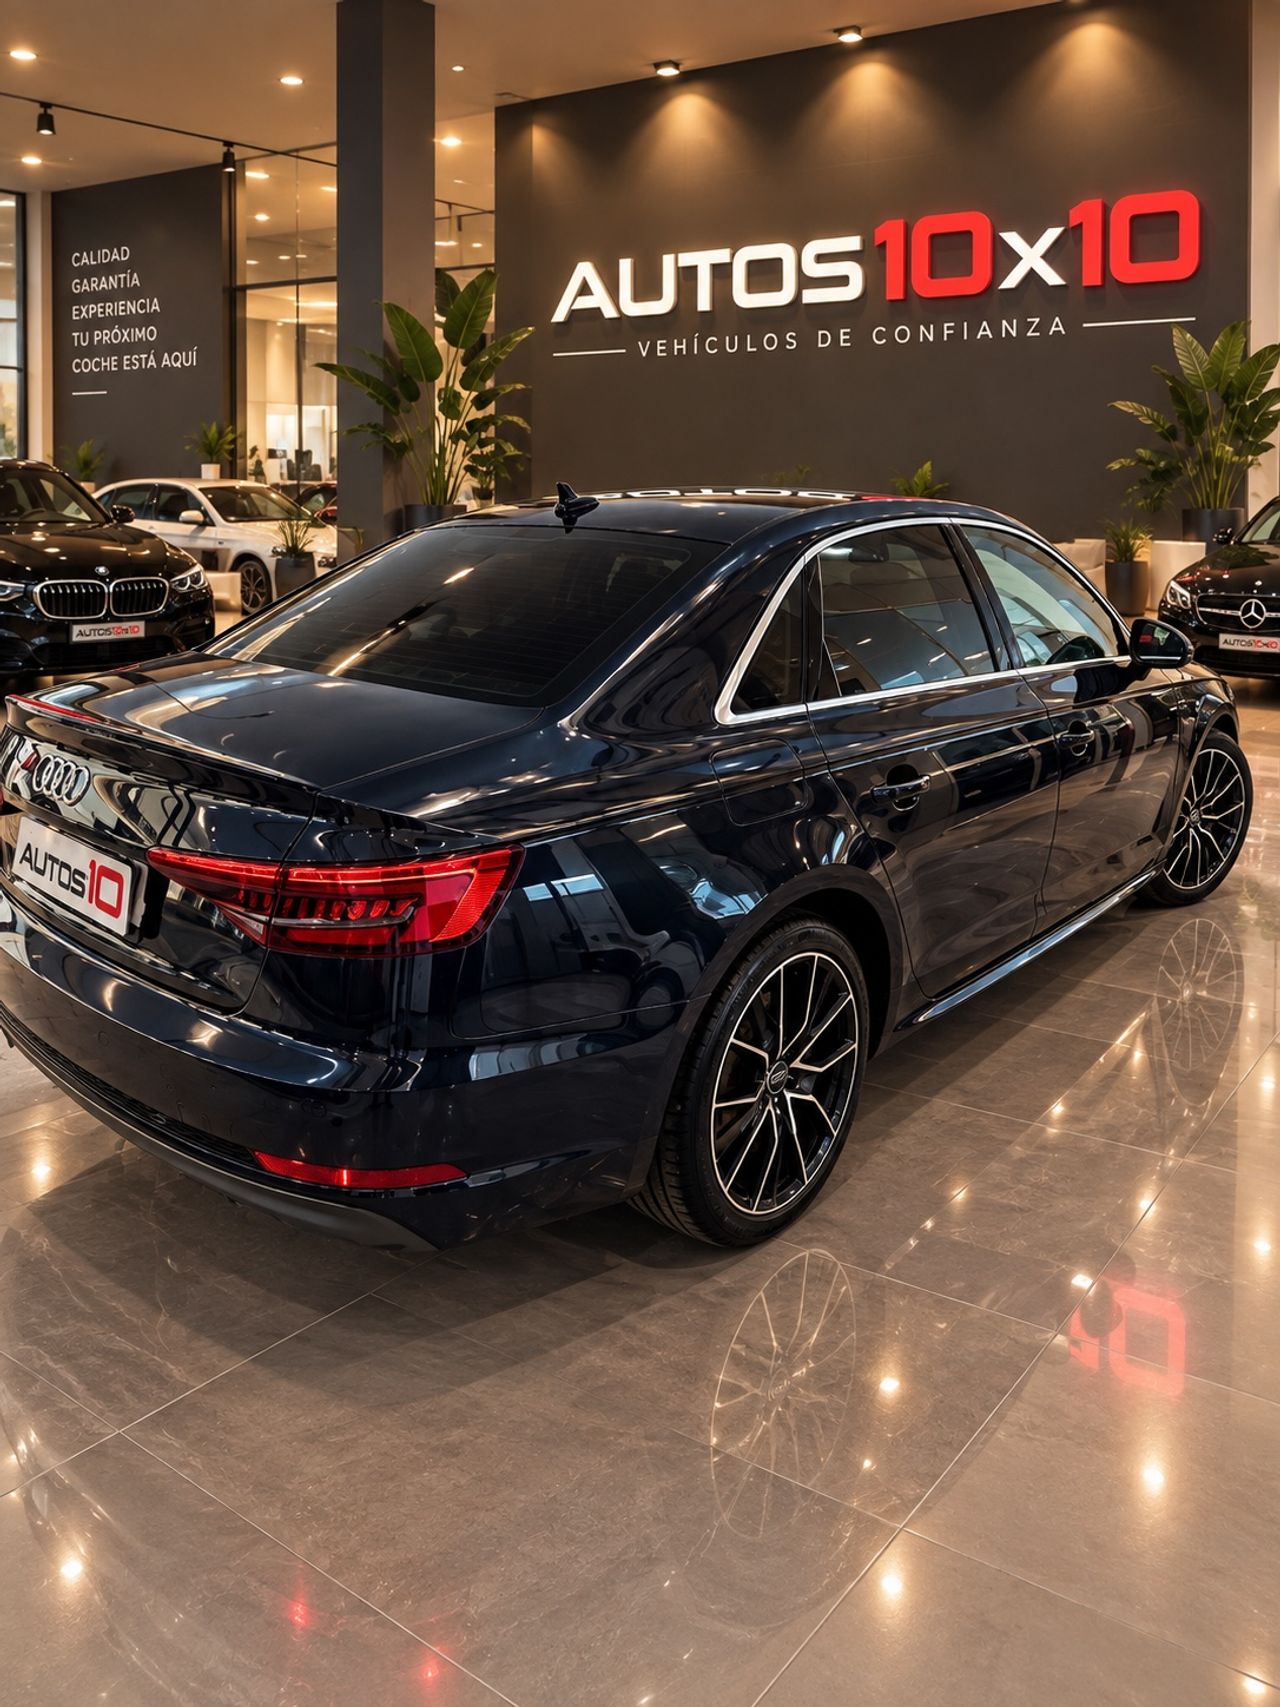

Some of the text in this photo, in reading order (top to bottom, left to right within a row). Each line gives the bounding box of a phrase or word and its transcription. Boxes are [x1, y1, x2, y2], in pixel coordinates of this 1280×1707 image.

[71, 246, 130, 267] CALIDAD
[71, 269, 141, 294] GARANTÍA
[71, 297, 161, 320] EXPERIENCIA
[71, 325, 157, 347] TU PRÓXIMO
[637, 316, 1067, 358] VEHÍCULOS DE CONFIANZA
[71, 346, 198, 373] COCHE ESTÁ AQUÍ
[19, 842, 125, 919] AUTOS10
